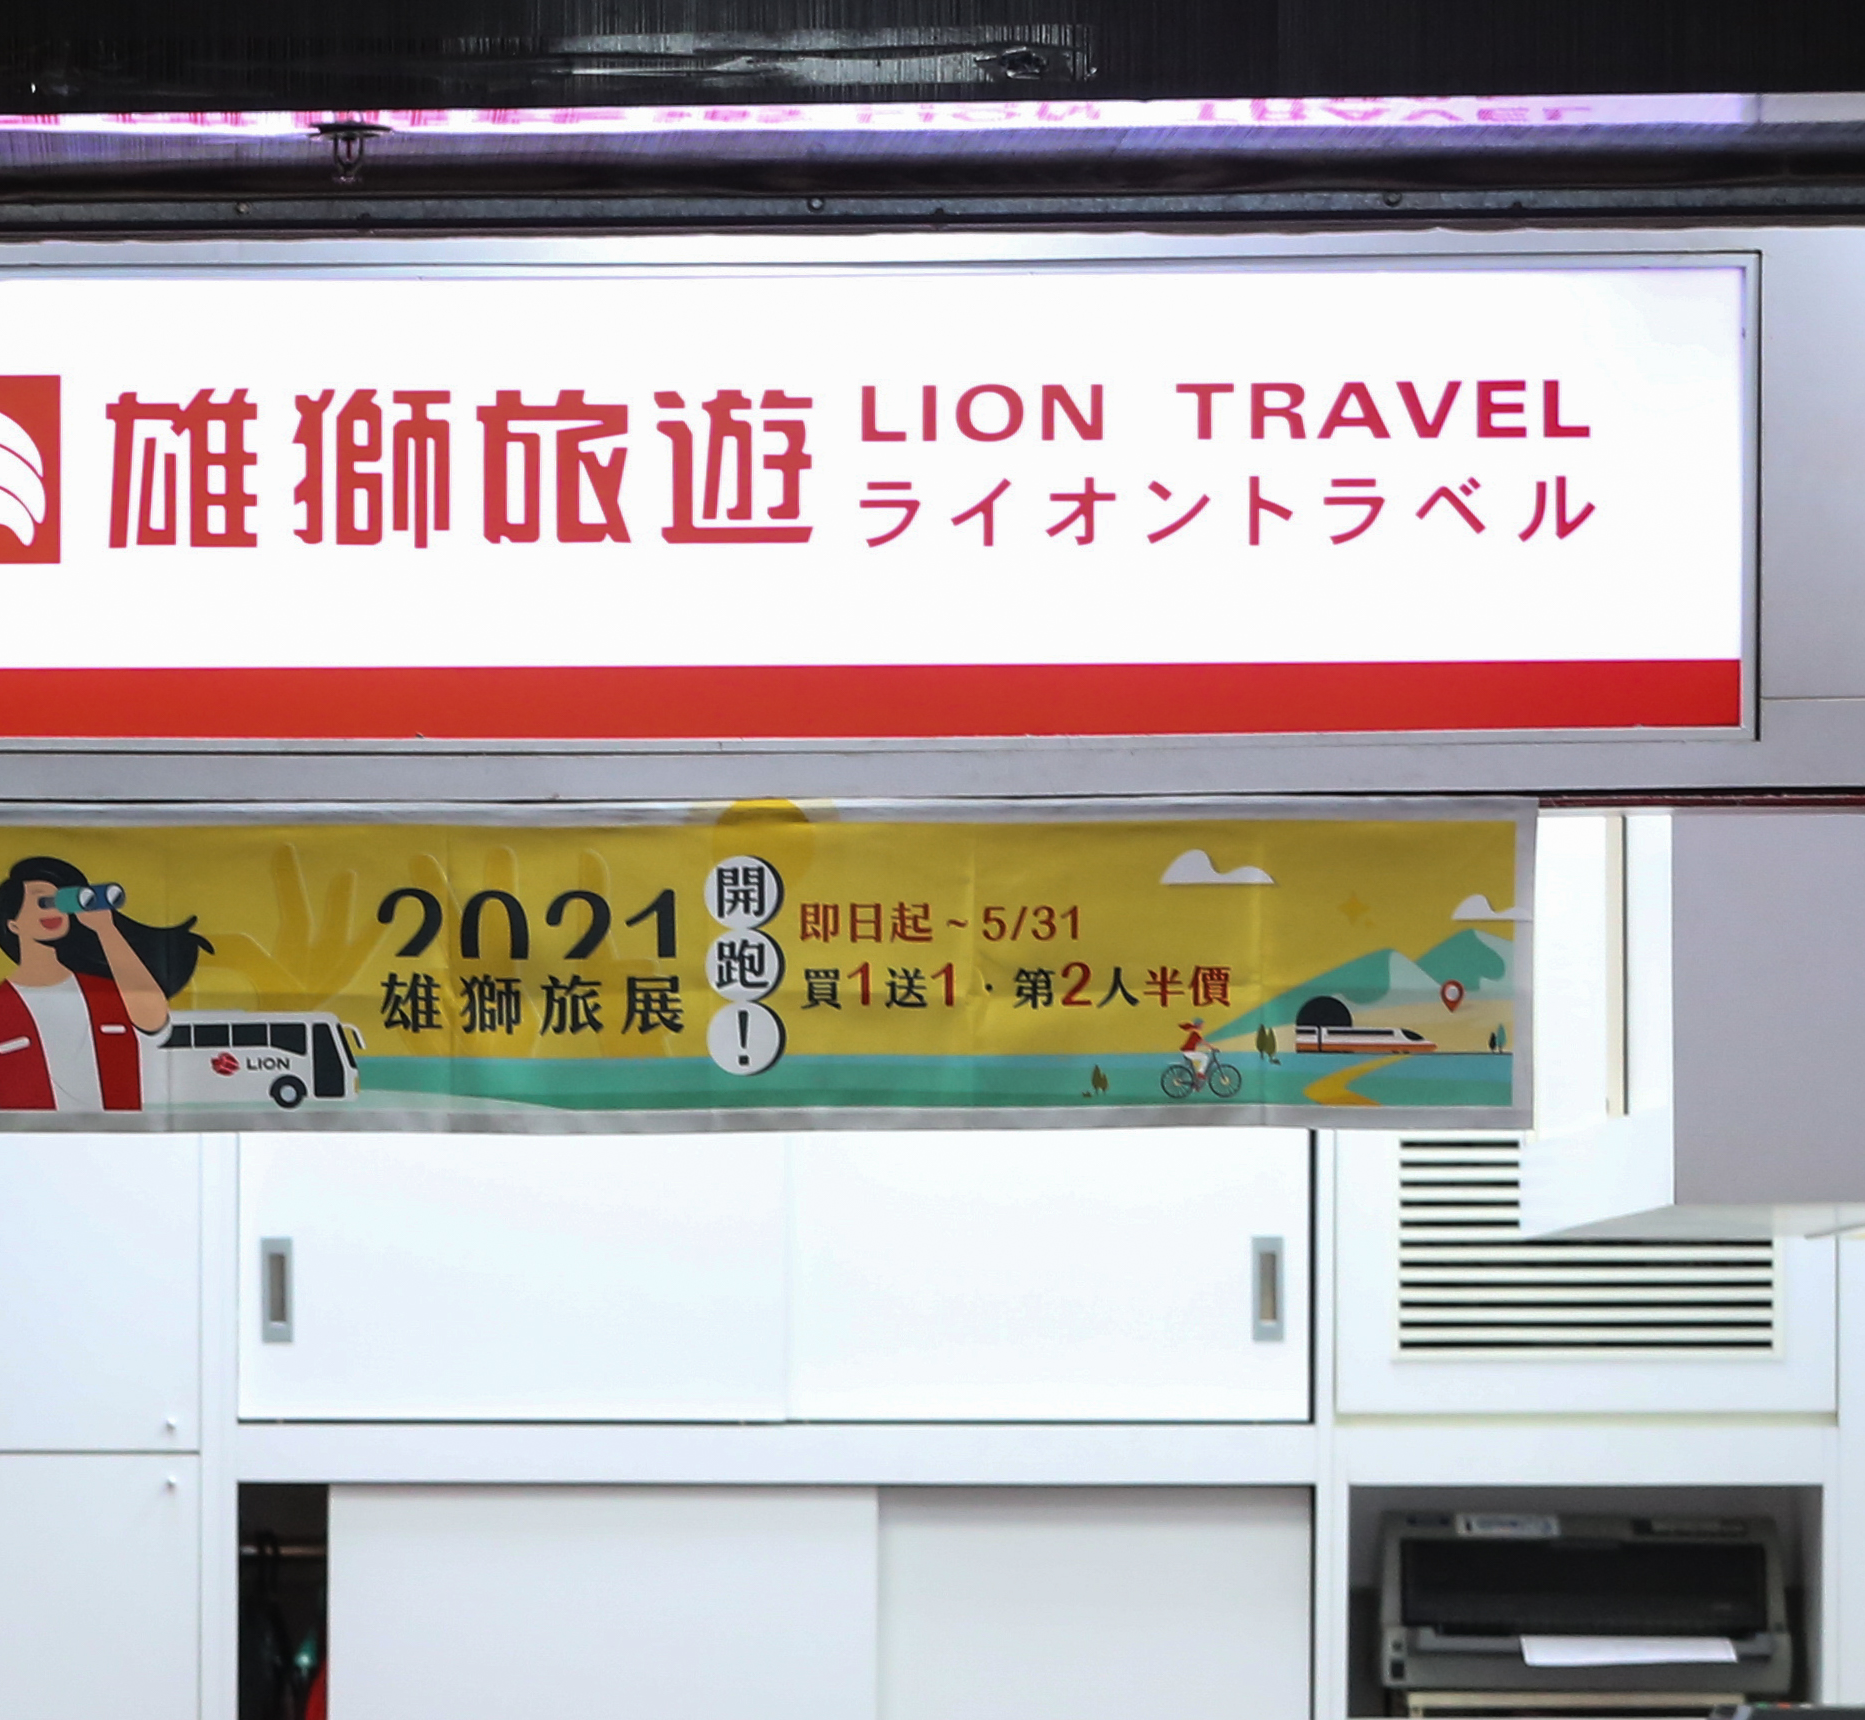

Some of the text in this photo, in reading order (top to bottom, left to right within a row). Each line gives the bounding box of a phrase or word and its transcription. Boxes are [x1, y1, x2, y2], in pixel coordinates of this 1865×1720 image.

[861, 379, 1591, 442] LION TRAVEL
[105, 387, 814, 549] 雄獅旅遊
[859, 475, 1596, 547] ライオントラベル
[377, 887, 678, 960] 2021
[380, 972, 686, 1035] 雄獅旅展
[246, 1055, 291, 1072] LION
